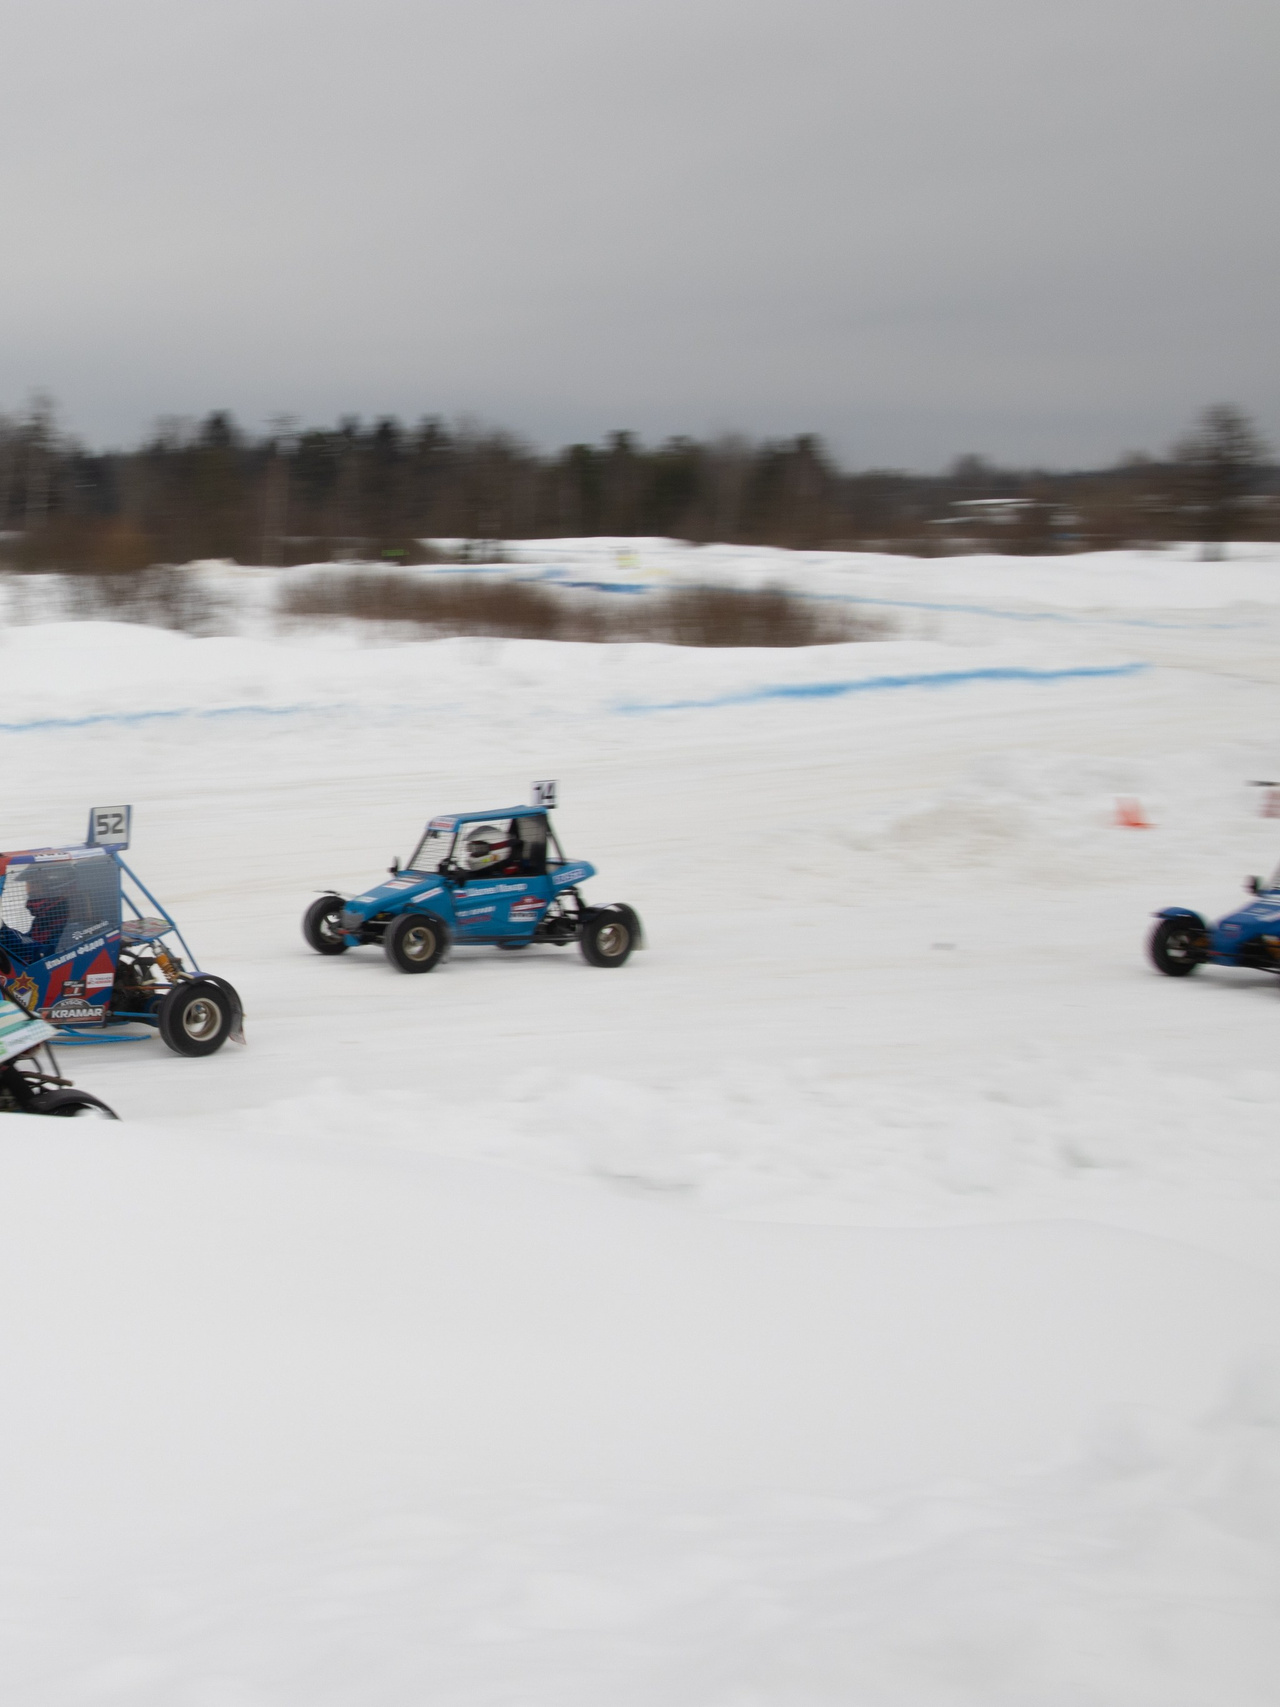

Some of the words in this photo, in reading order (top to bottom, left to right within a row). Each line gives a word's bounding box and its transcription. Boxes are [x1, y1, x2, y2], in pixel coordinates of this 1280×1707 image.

[533, 783, 557, 804] 14
[96, 813, 124, 836] 52
[51, 1008, 104, 1019] KRAMAR
